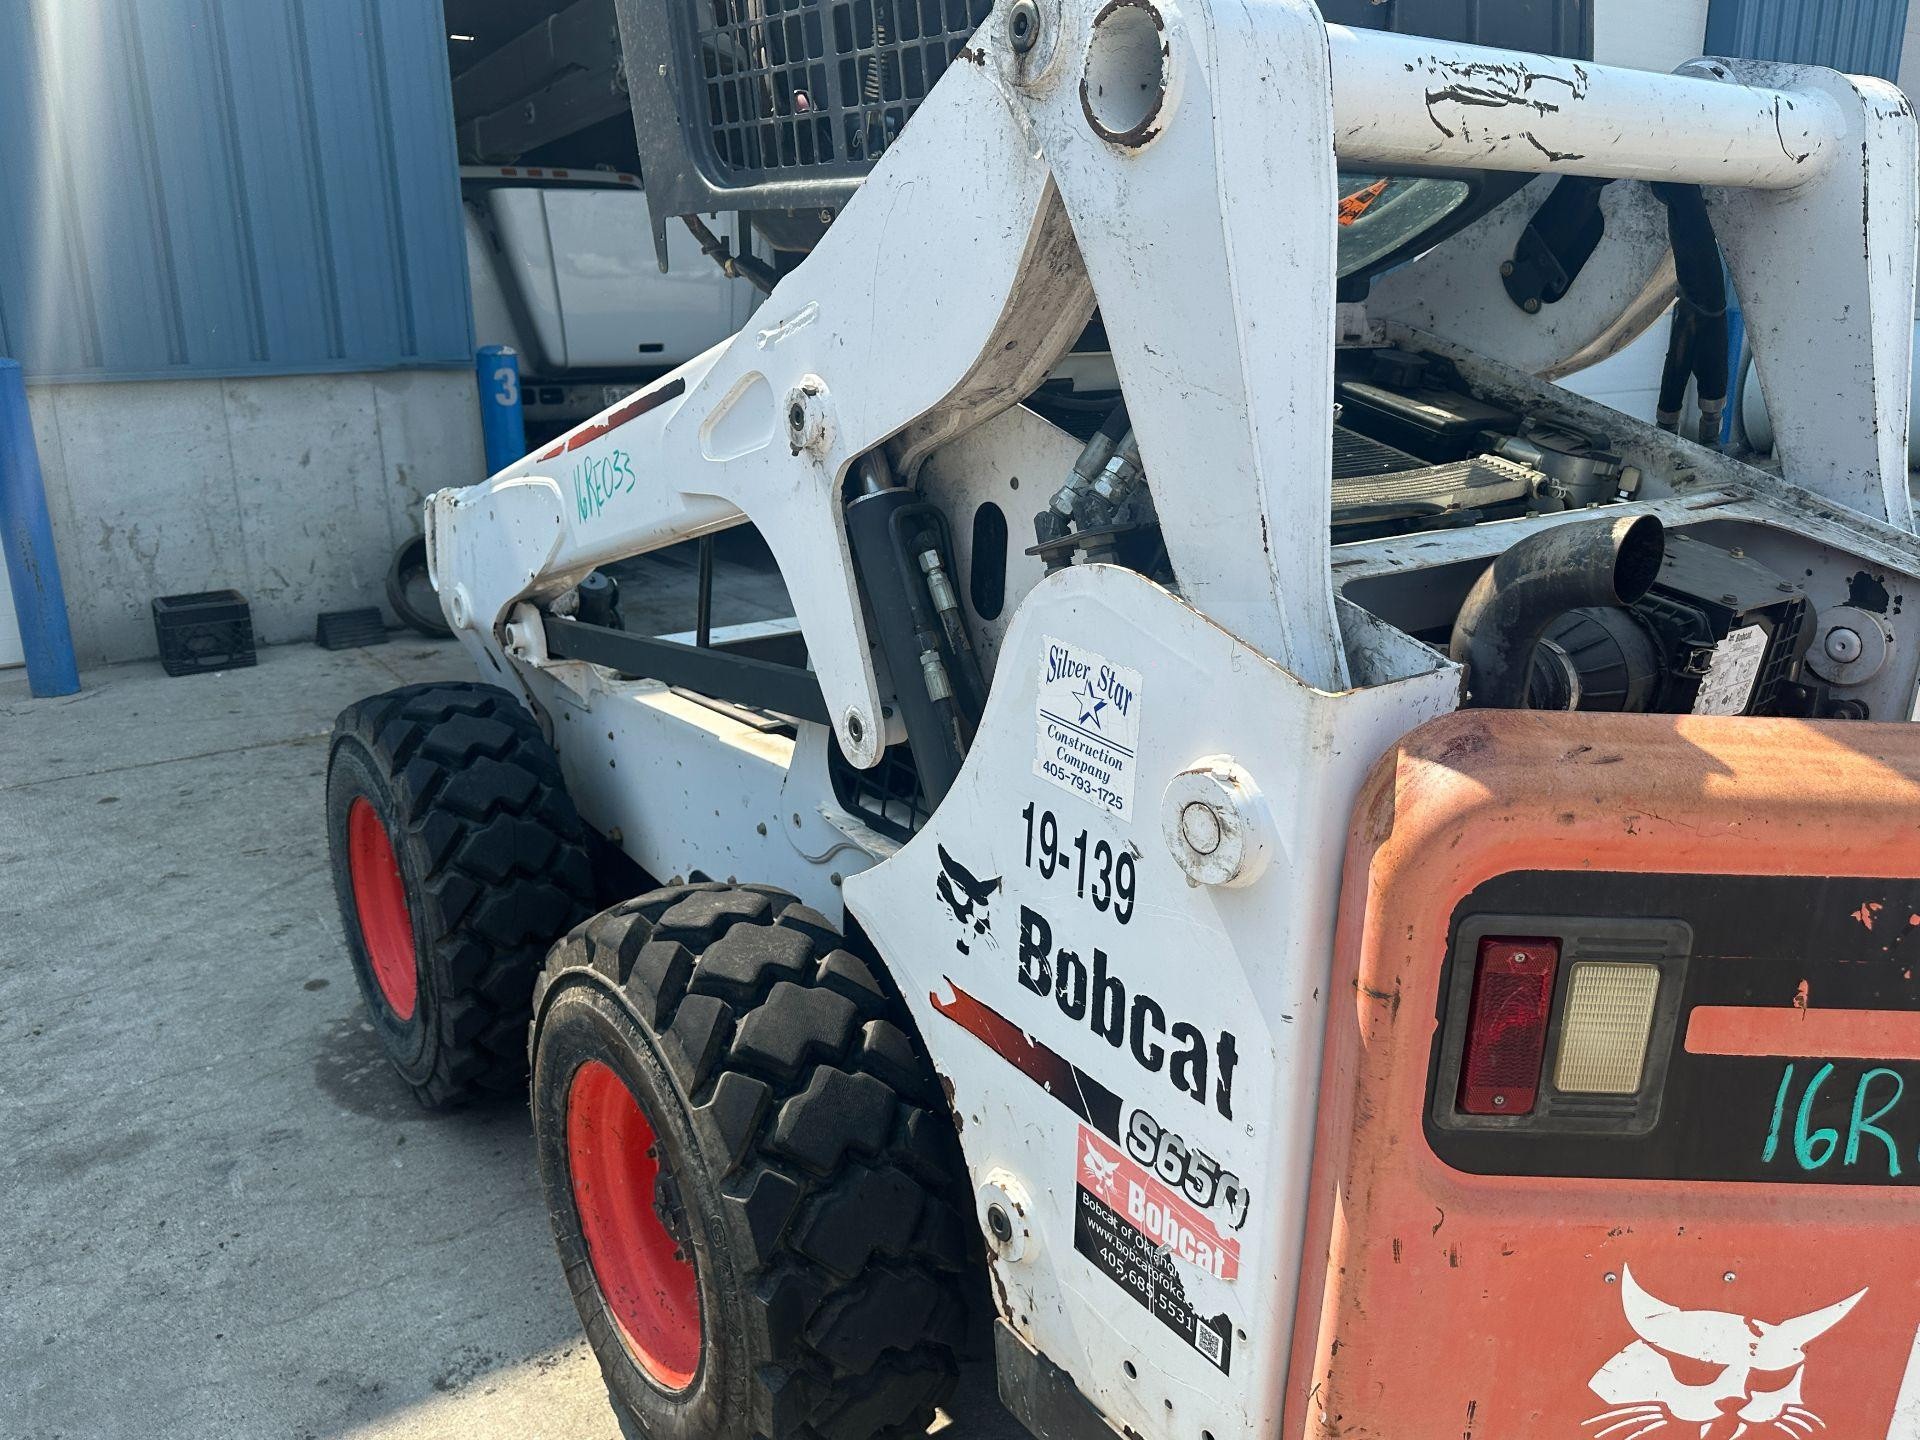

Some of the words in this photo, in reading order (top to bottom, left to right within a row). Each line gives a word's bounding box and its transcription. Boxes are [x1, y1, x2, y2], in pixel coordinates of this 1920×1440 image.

[493, 367, 518, 406] 3
[573, 449, 636, 525] 16RE033
[1046, 644, 1091, 684] Silver
[1097, 664, 1133, 717] Star
[1047, 723, 1123, 771] Construction
[1056, 746, 1111, 784] Company
[1042, 760, 1124, 810] 405-793-1725
[1022, 801, 1136, 925] 19-139
[1018, 904, 1239, 1121] Bobcat
[1761, 1062, 1920, 1178] 16R
[1126, 1108, 1251, 1232] S650
[1082, 1191, 1119, 1230] Bobcat
[1121, 1225, 1133, 1240] of
[1128, 1179, 1225, 1279] Bobcat
